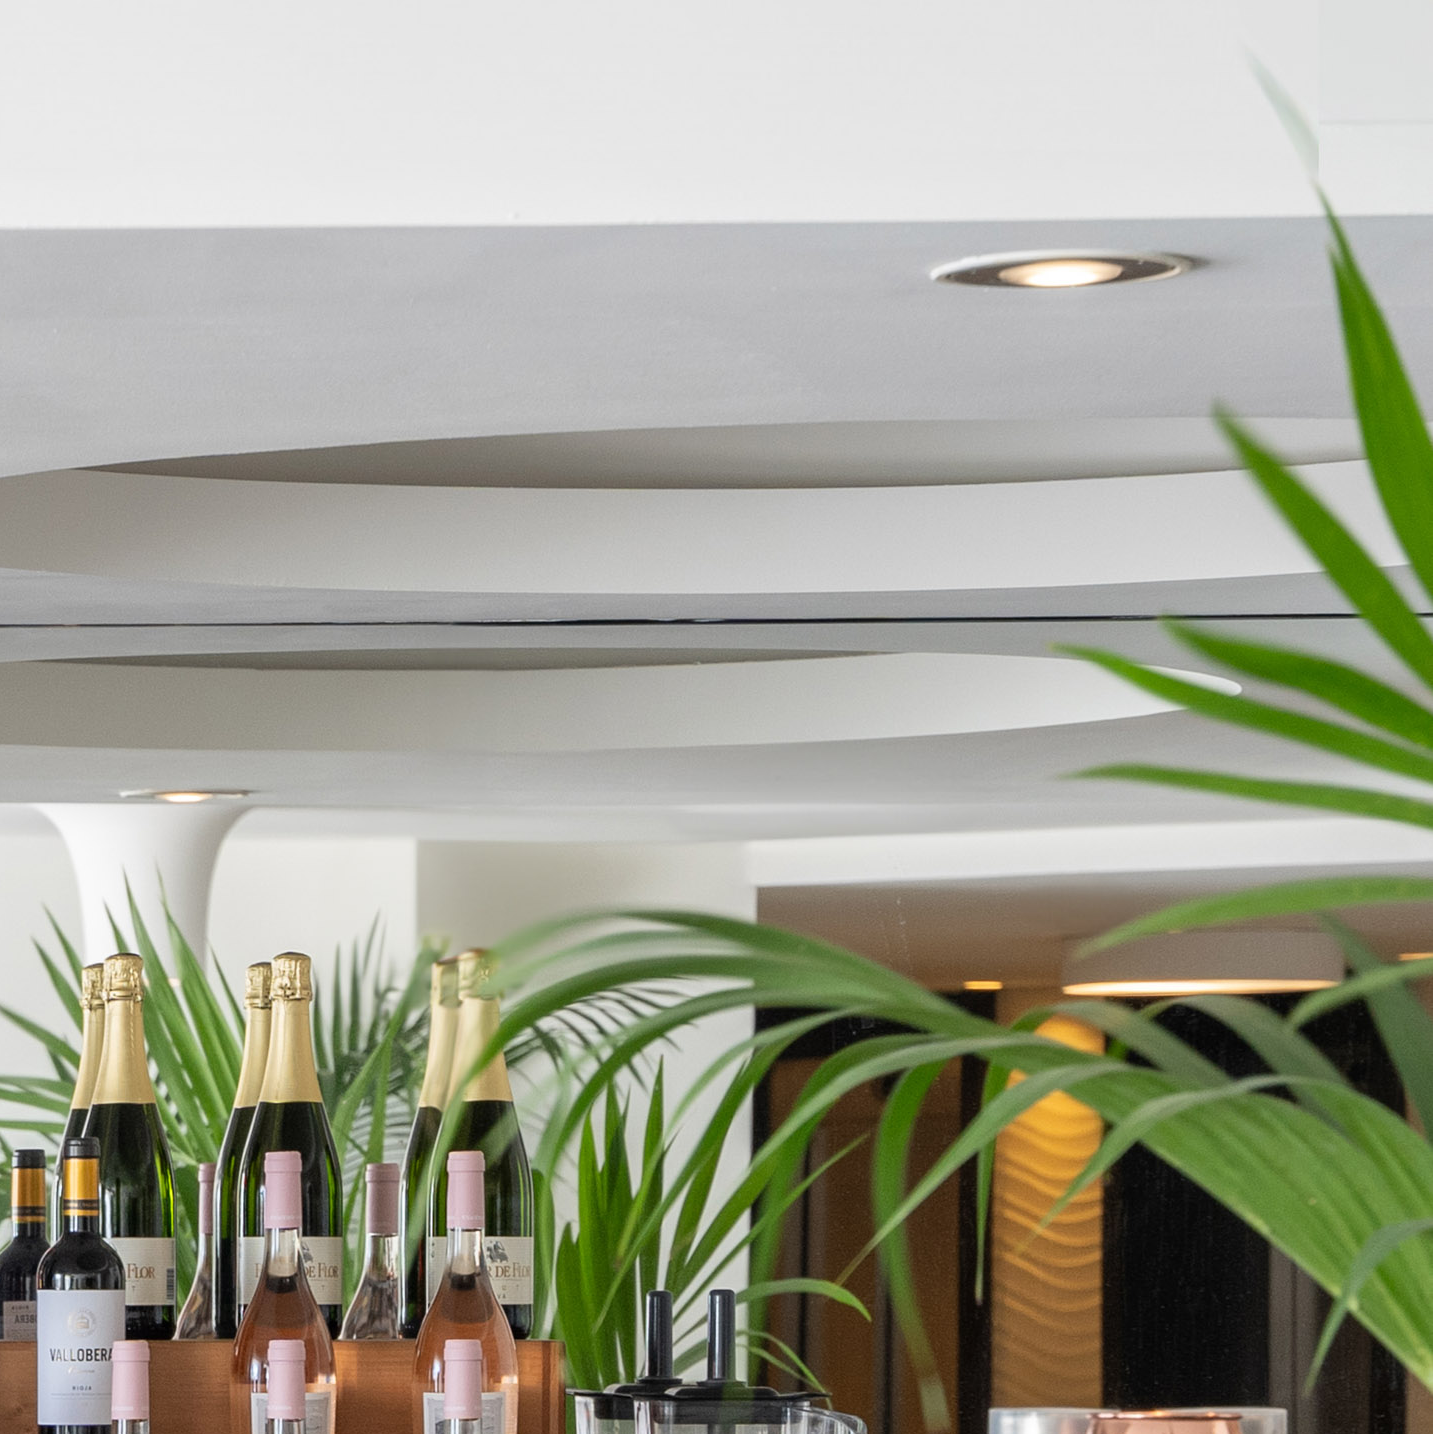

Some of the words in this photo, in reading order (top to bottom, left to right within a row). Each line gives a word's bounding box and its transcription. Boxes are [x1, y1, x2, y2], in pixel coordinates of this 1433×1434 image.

[127, 1263, 156, 1279] FLOR
[317, 1263, 339, 1279] FLOR
[495, 1265, 511, 1278] DE
